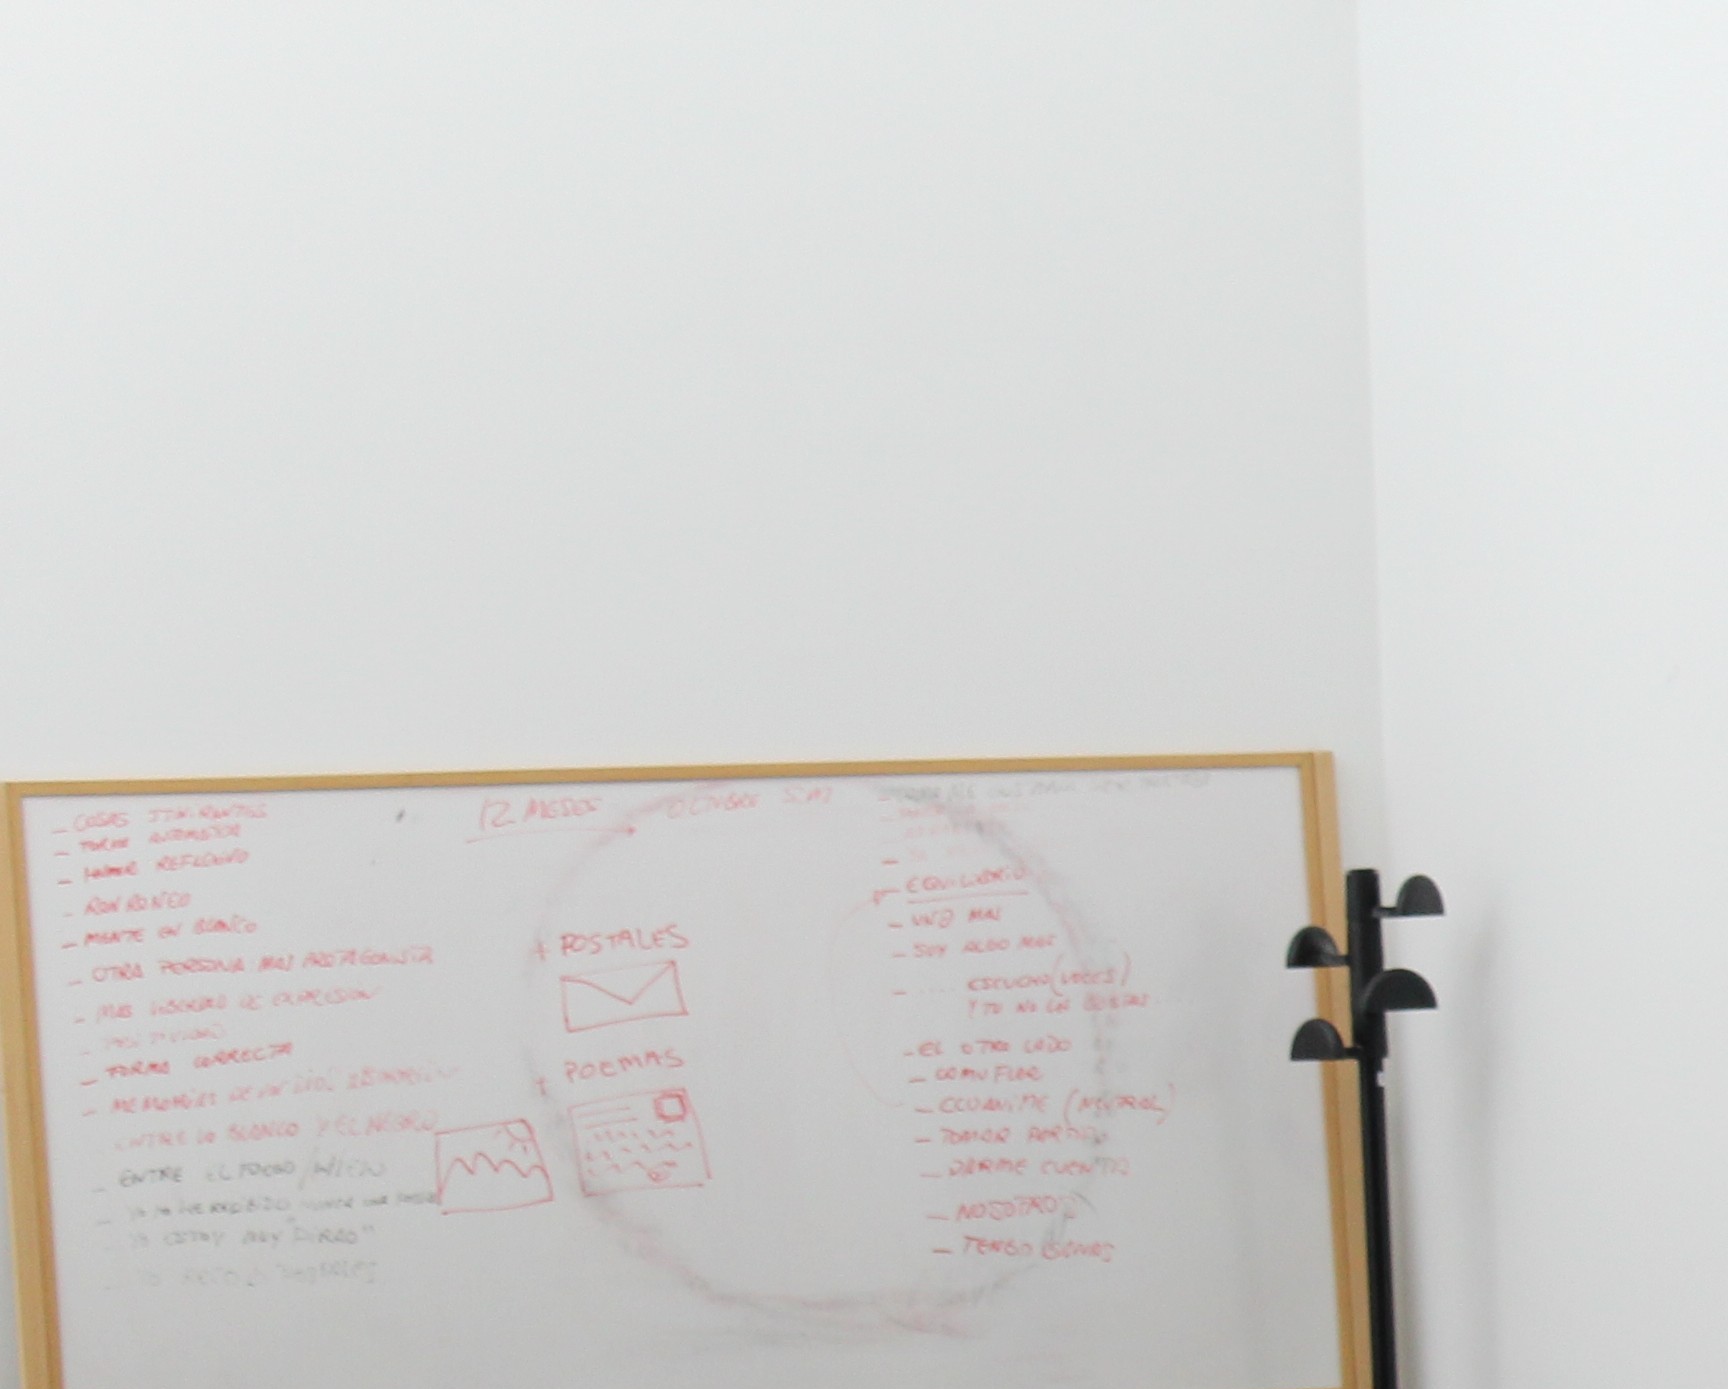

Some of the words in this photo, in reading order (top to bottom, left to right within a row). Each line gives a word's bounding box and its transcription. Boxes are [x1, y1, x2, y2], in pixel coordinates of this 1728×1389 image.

[480, 802, 512, 829] 12
[559, 923, 692, 957] POSTALES
[564, 1048, 686, 1082] POEMAS
